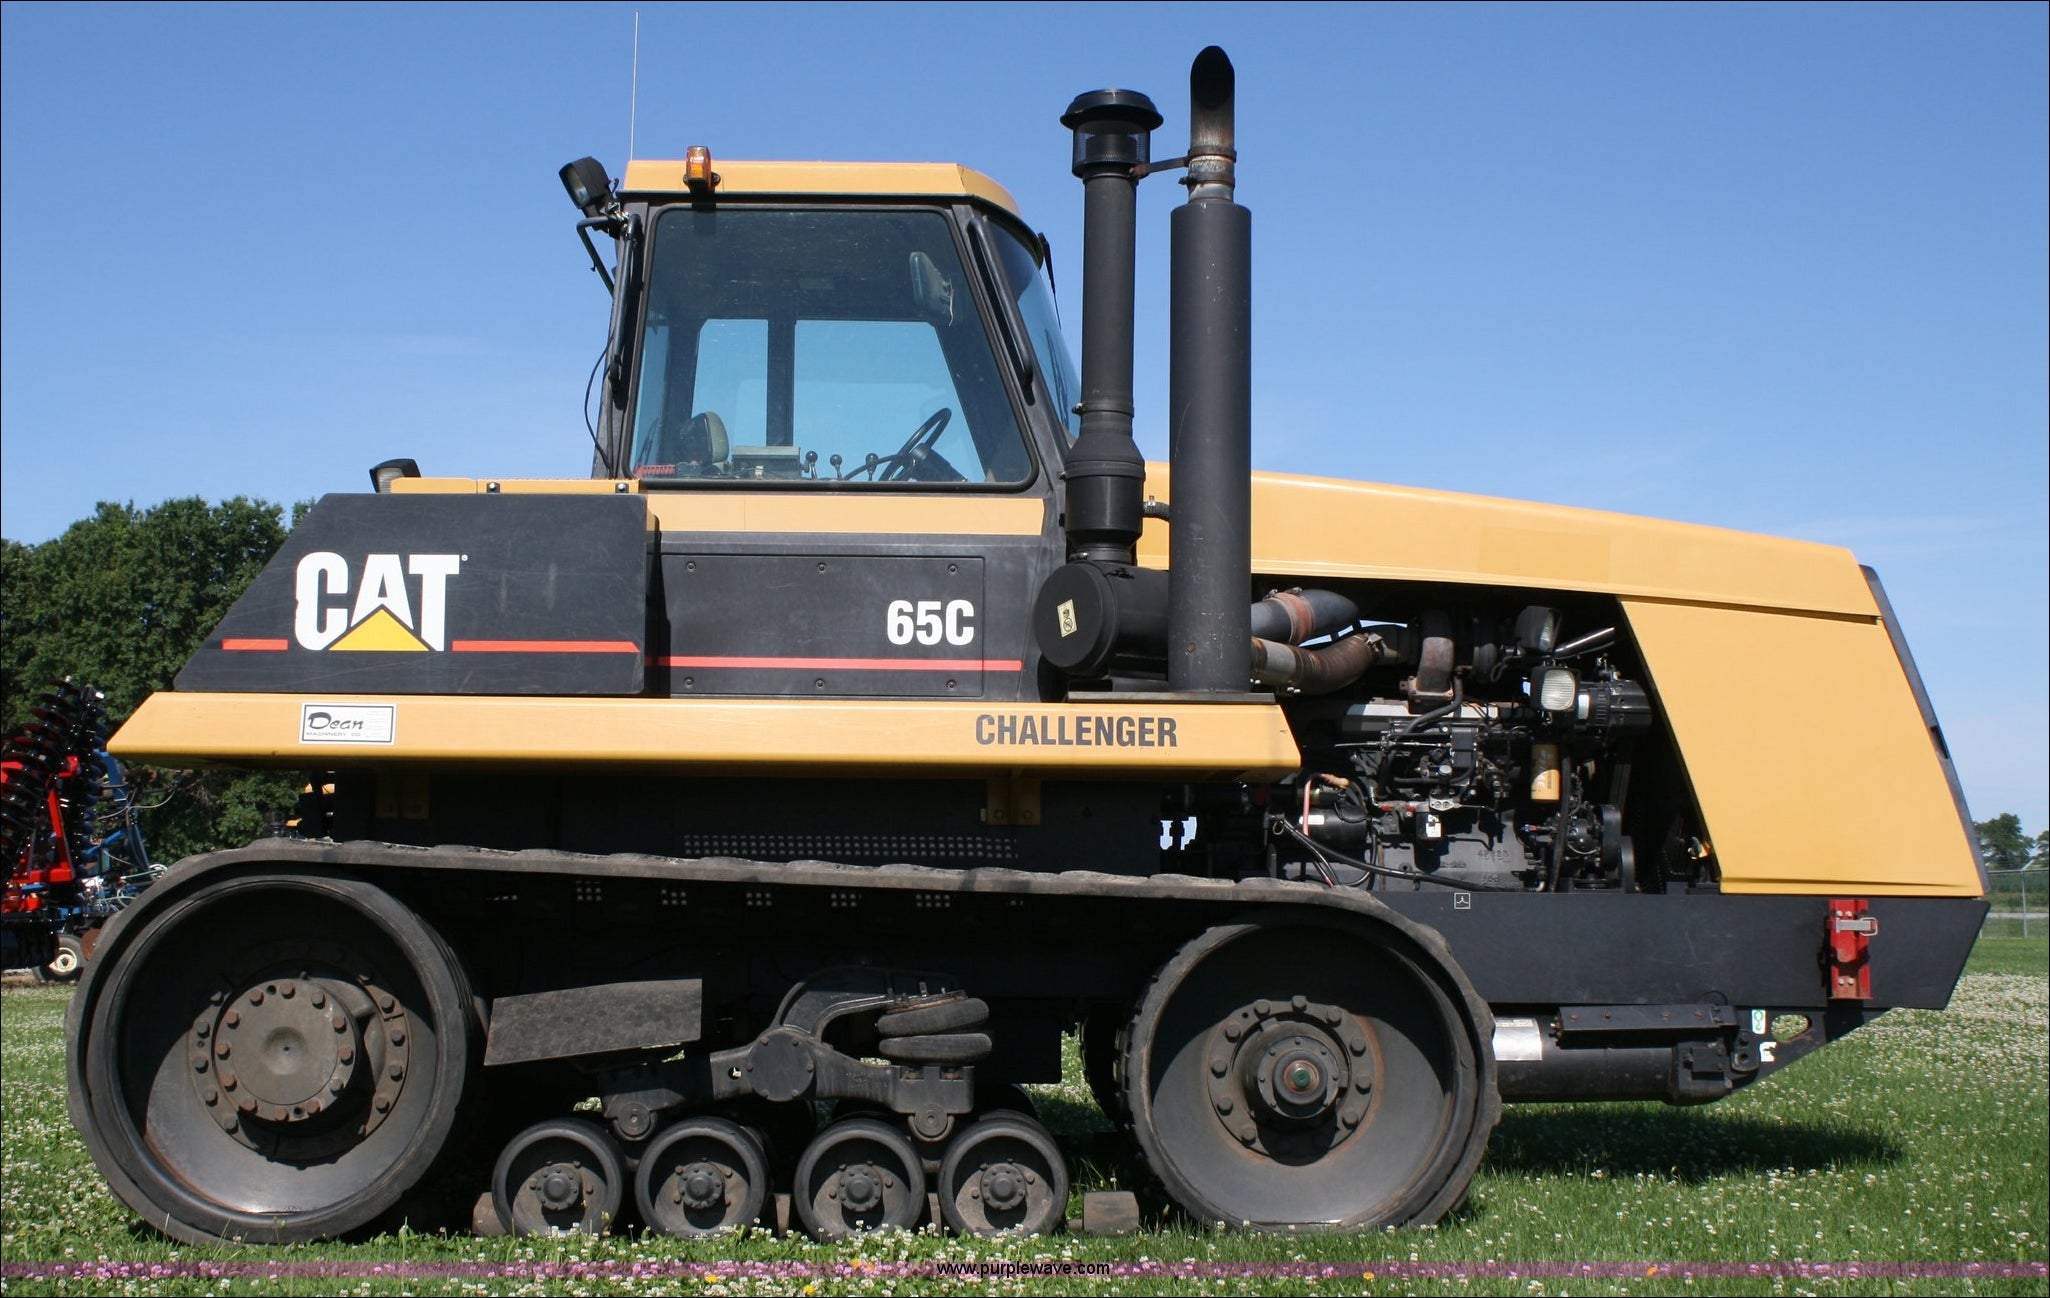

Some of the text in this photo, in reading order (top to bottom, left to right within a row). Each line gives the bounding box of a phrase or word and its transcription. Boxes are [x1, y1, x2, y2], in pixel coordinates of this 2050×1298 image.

[295, 551, 460, 652] CAT
[886, 599, 975, 646] 65C
[307, 712, 364, 730] Dean
[975, 714, 1178, 747] CHALLENGER
